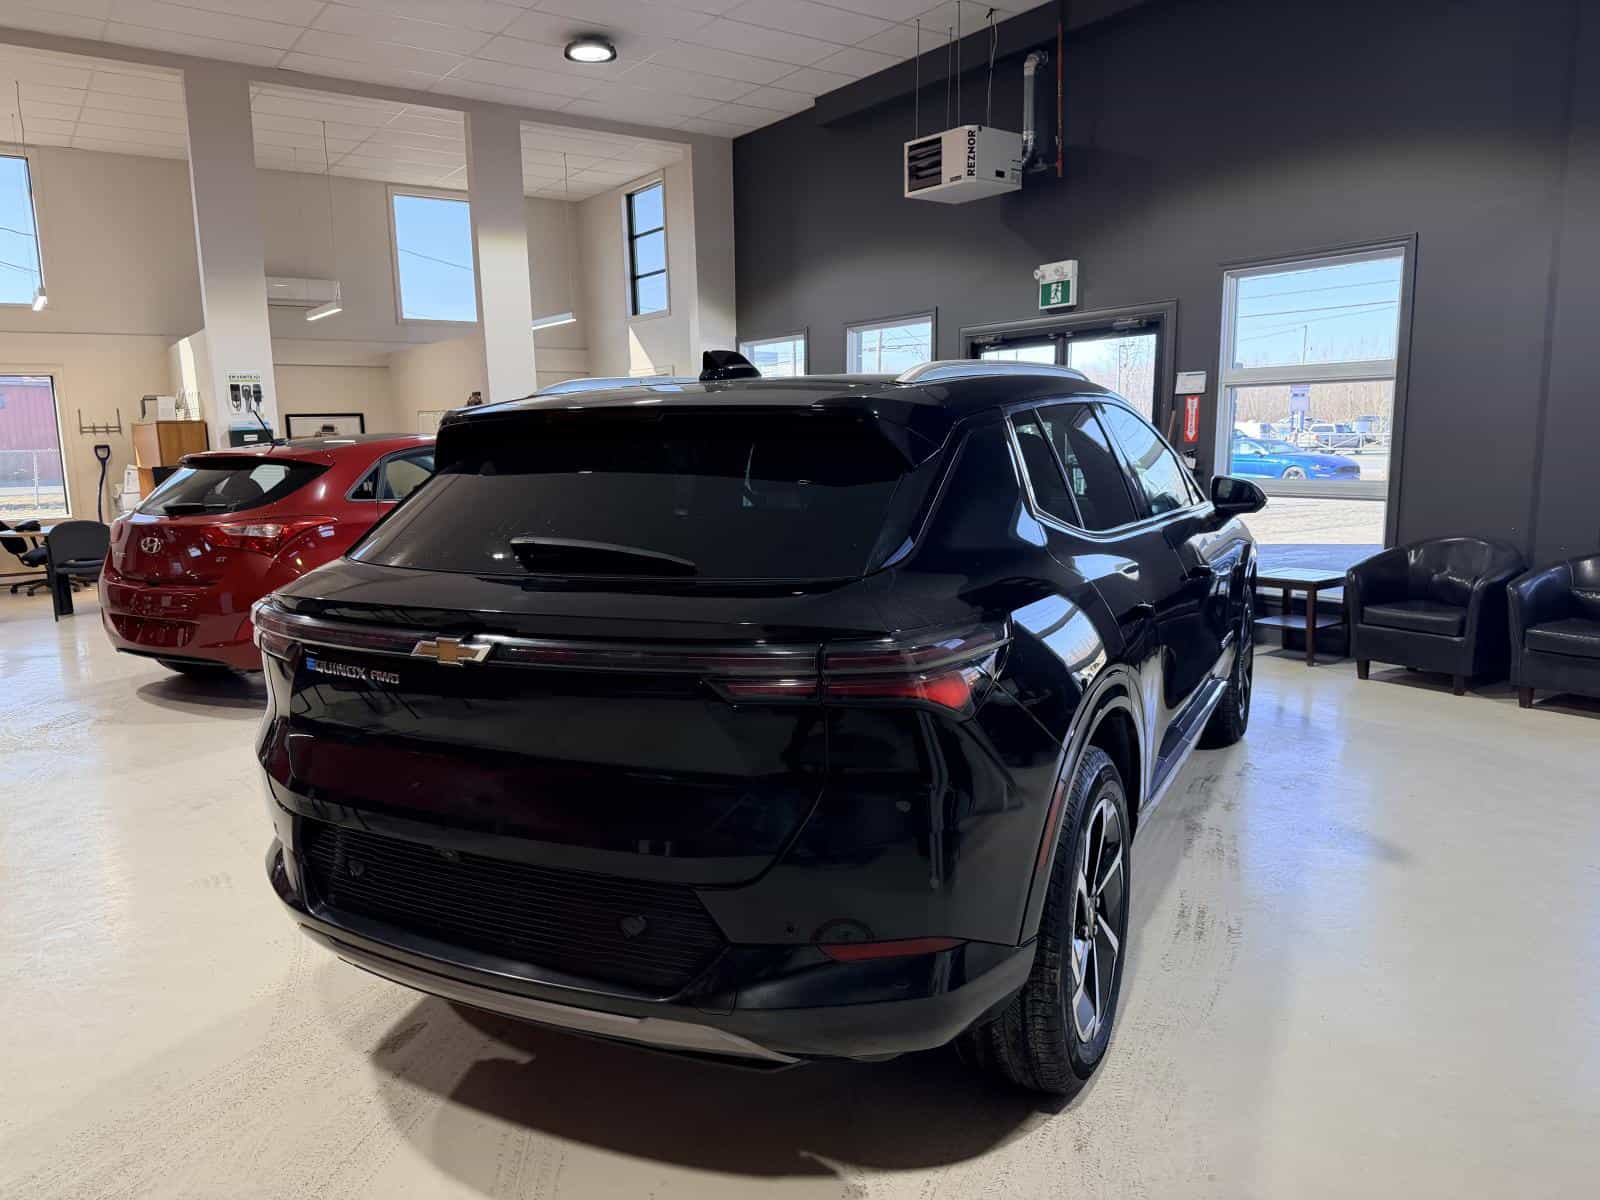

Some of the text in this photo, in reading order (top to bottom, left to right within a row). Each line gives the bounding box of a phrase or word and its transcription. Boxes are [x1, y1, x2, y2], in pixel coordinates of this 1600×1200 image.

[967, 130, 976, 177] REZNOR
[306, 657, 400, 684] EQUINOX AWD
